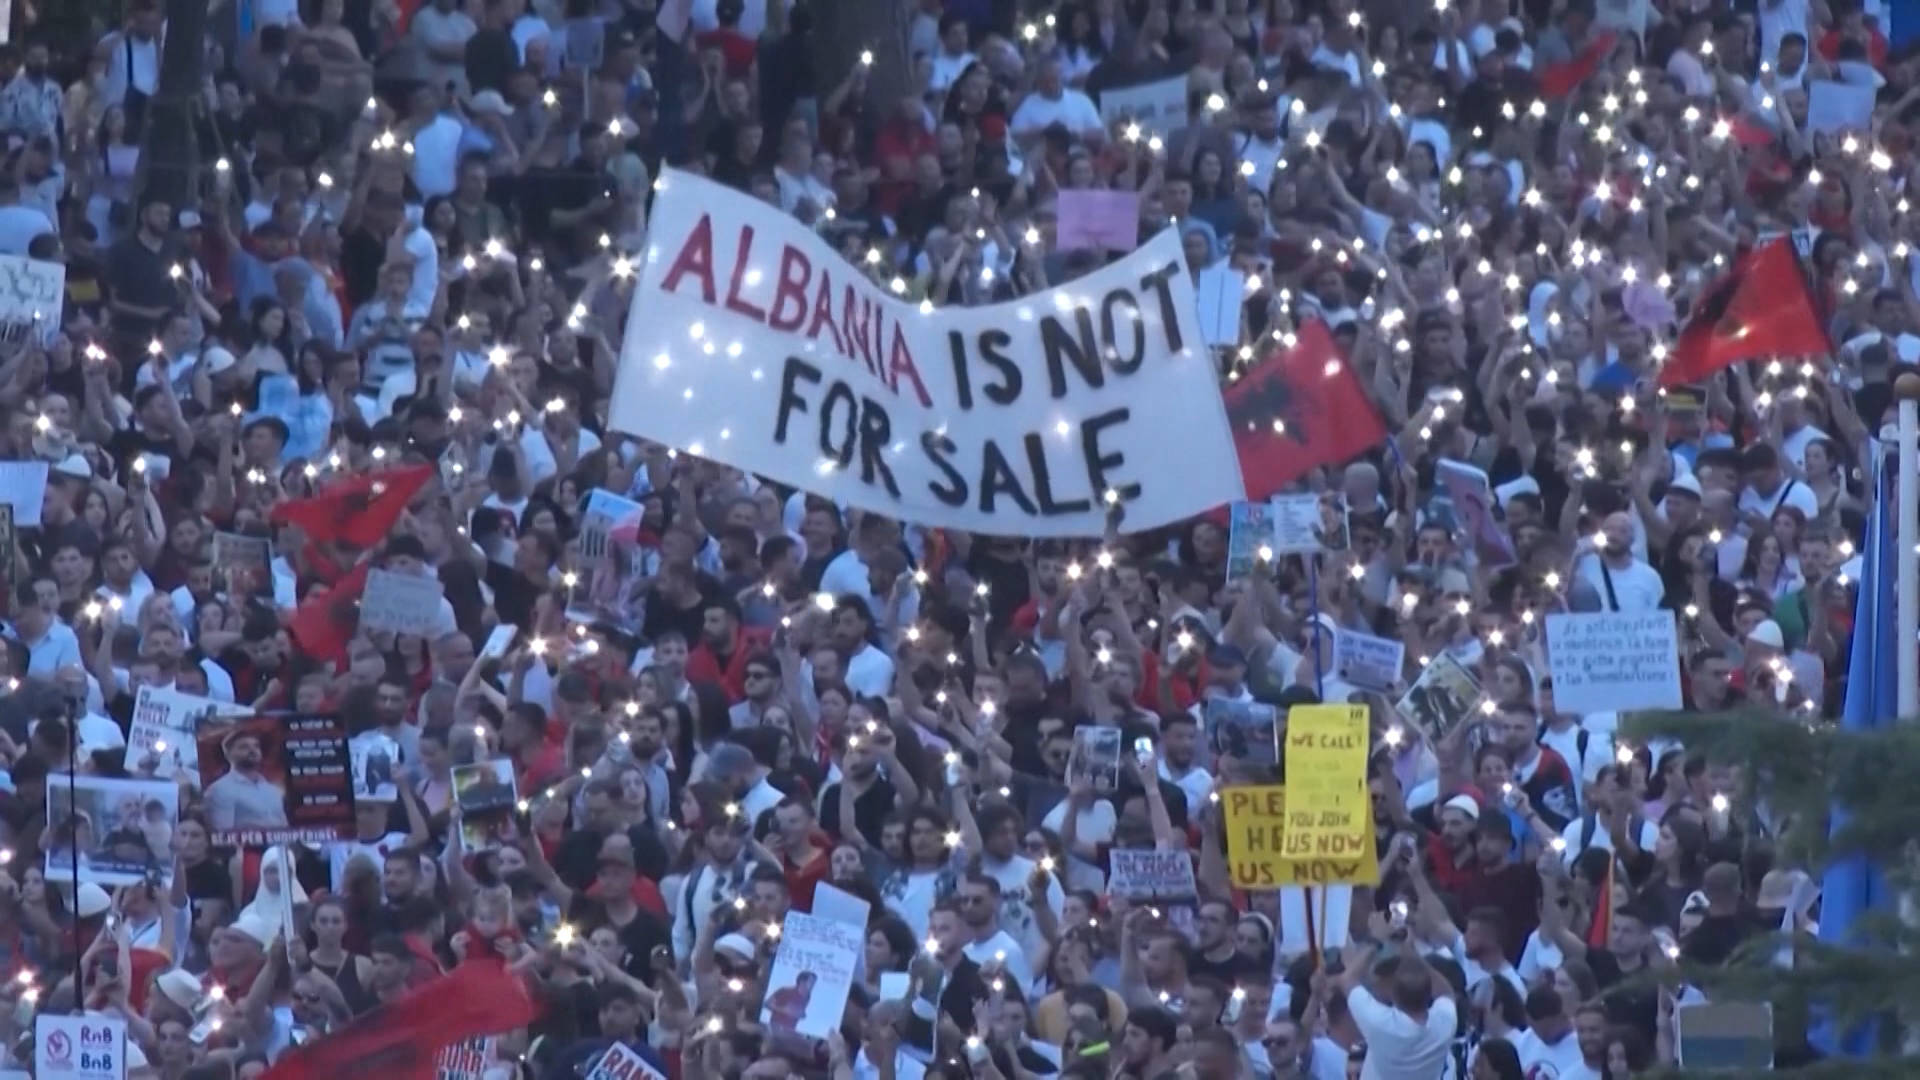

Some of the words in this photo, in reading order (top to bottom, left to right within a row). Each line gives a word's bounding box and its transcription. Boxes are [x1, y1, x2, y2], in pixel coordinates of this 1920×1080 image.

[660, 212, 933, 408] ALBANIA
[948, 329, 1022, 411] IS
[1039, 260, 1183, 399] NOT
[774, 356, 901, 498] FOR
[920, 407, 1141, 516] SALE
[1289, 812, 1315, 828] YOU
[1317, 811, 1351, 828] JOIN
[1285, 833, 1312, 854] US
[1317, 833, 1364, 852] NOW
[1238, 861, 1275, 885] US
[1292, 862, 1361, 883] NOW
[81, 1024, 113, 1043] RnB
[81, 1052, 112, 1071] BnB
[602, 1048, 661, 1080] RAM
